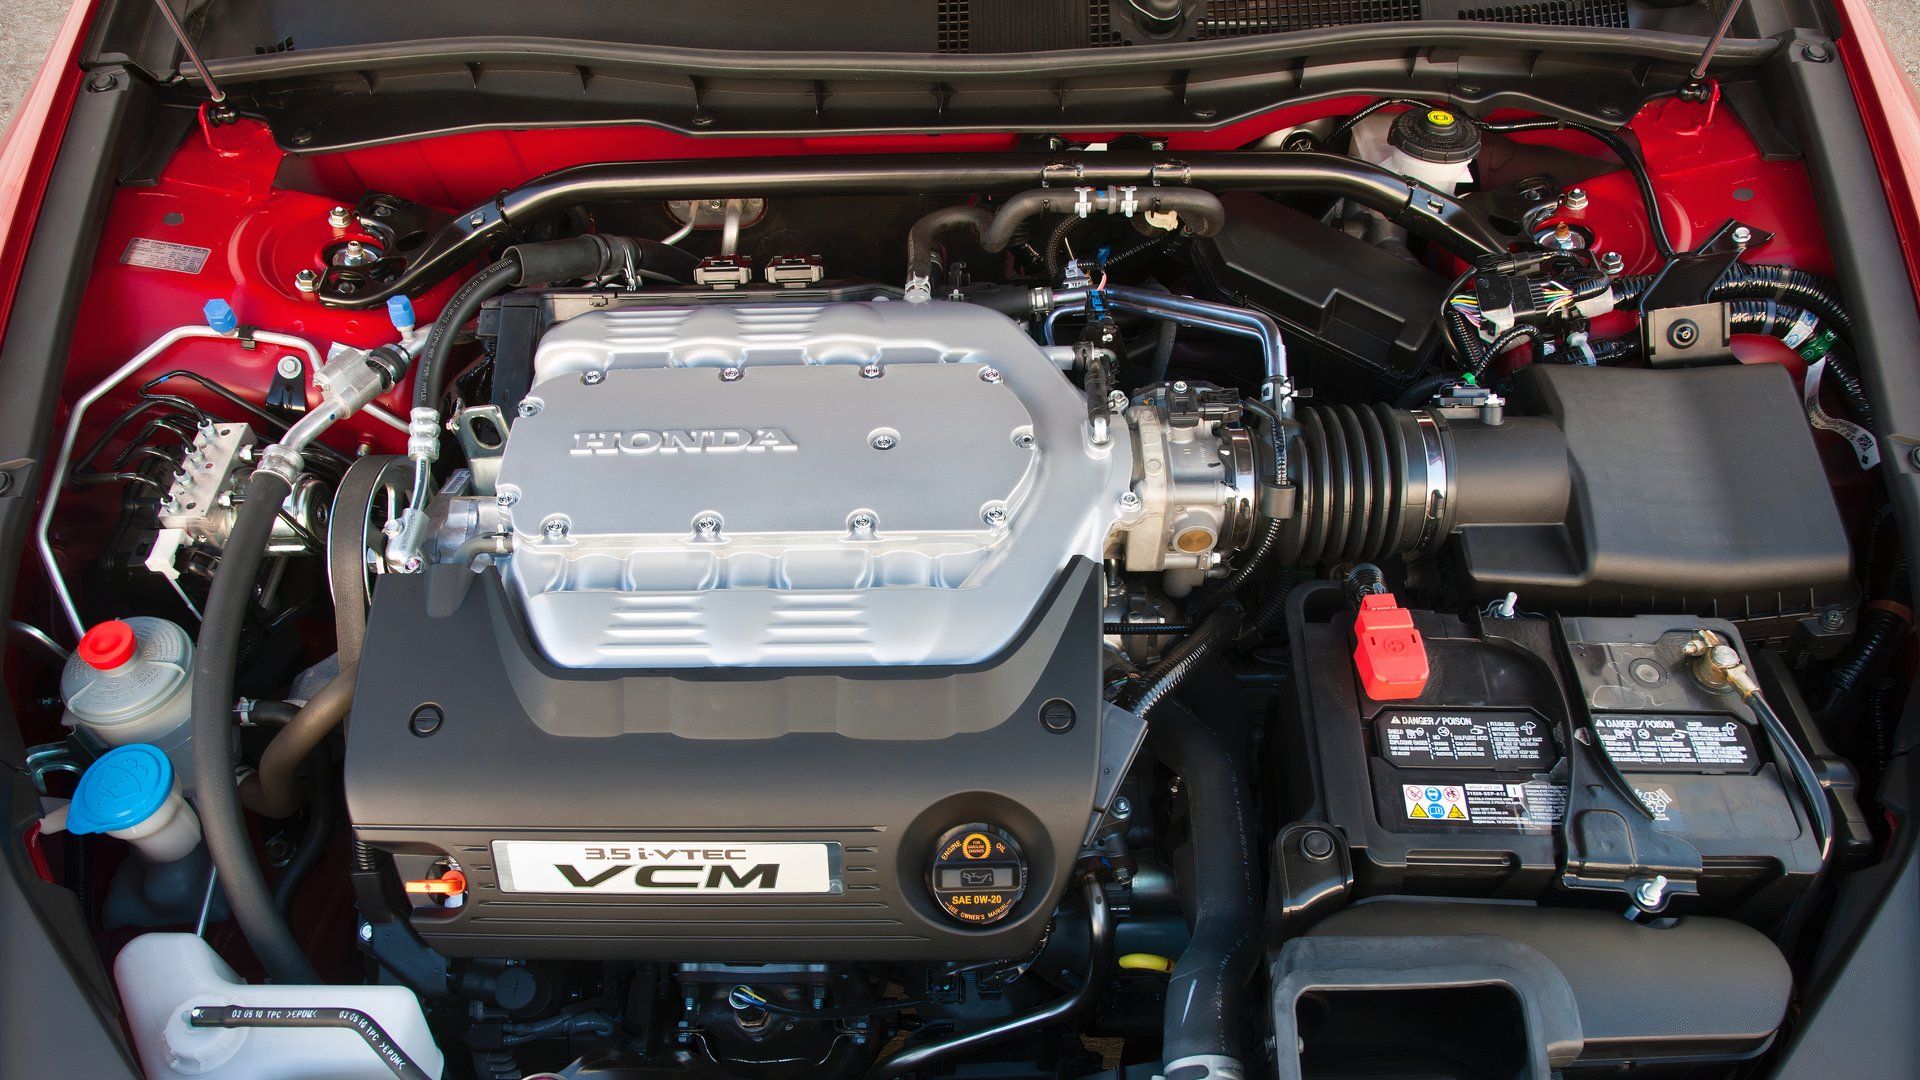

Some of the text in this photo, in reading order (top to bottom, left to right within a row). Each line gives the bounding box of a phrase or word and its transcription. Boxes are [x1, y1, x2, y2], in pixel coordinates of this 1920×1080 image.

[569, 427, 798, 455] HONDA
[1402, 716, 1434, 725] DANGER
[1442, 718, 1472, 726] POISON
[1606, 720, 1637, 728] DANGER
[1645, 720, 1675, 729] POISON
[586, 848, 746, 860] 3.5 i-VTEC
[941, 840, 1006, 861] ENGINE OIL
[553, 864, 781, 888] VCM
[952, 895, 1002, 904] SAE 0W-20
[987, 903, 1009, 918] MANUAL
[232, 1010, 242, 1018] 03
